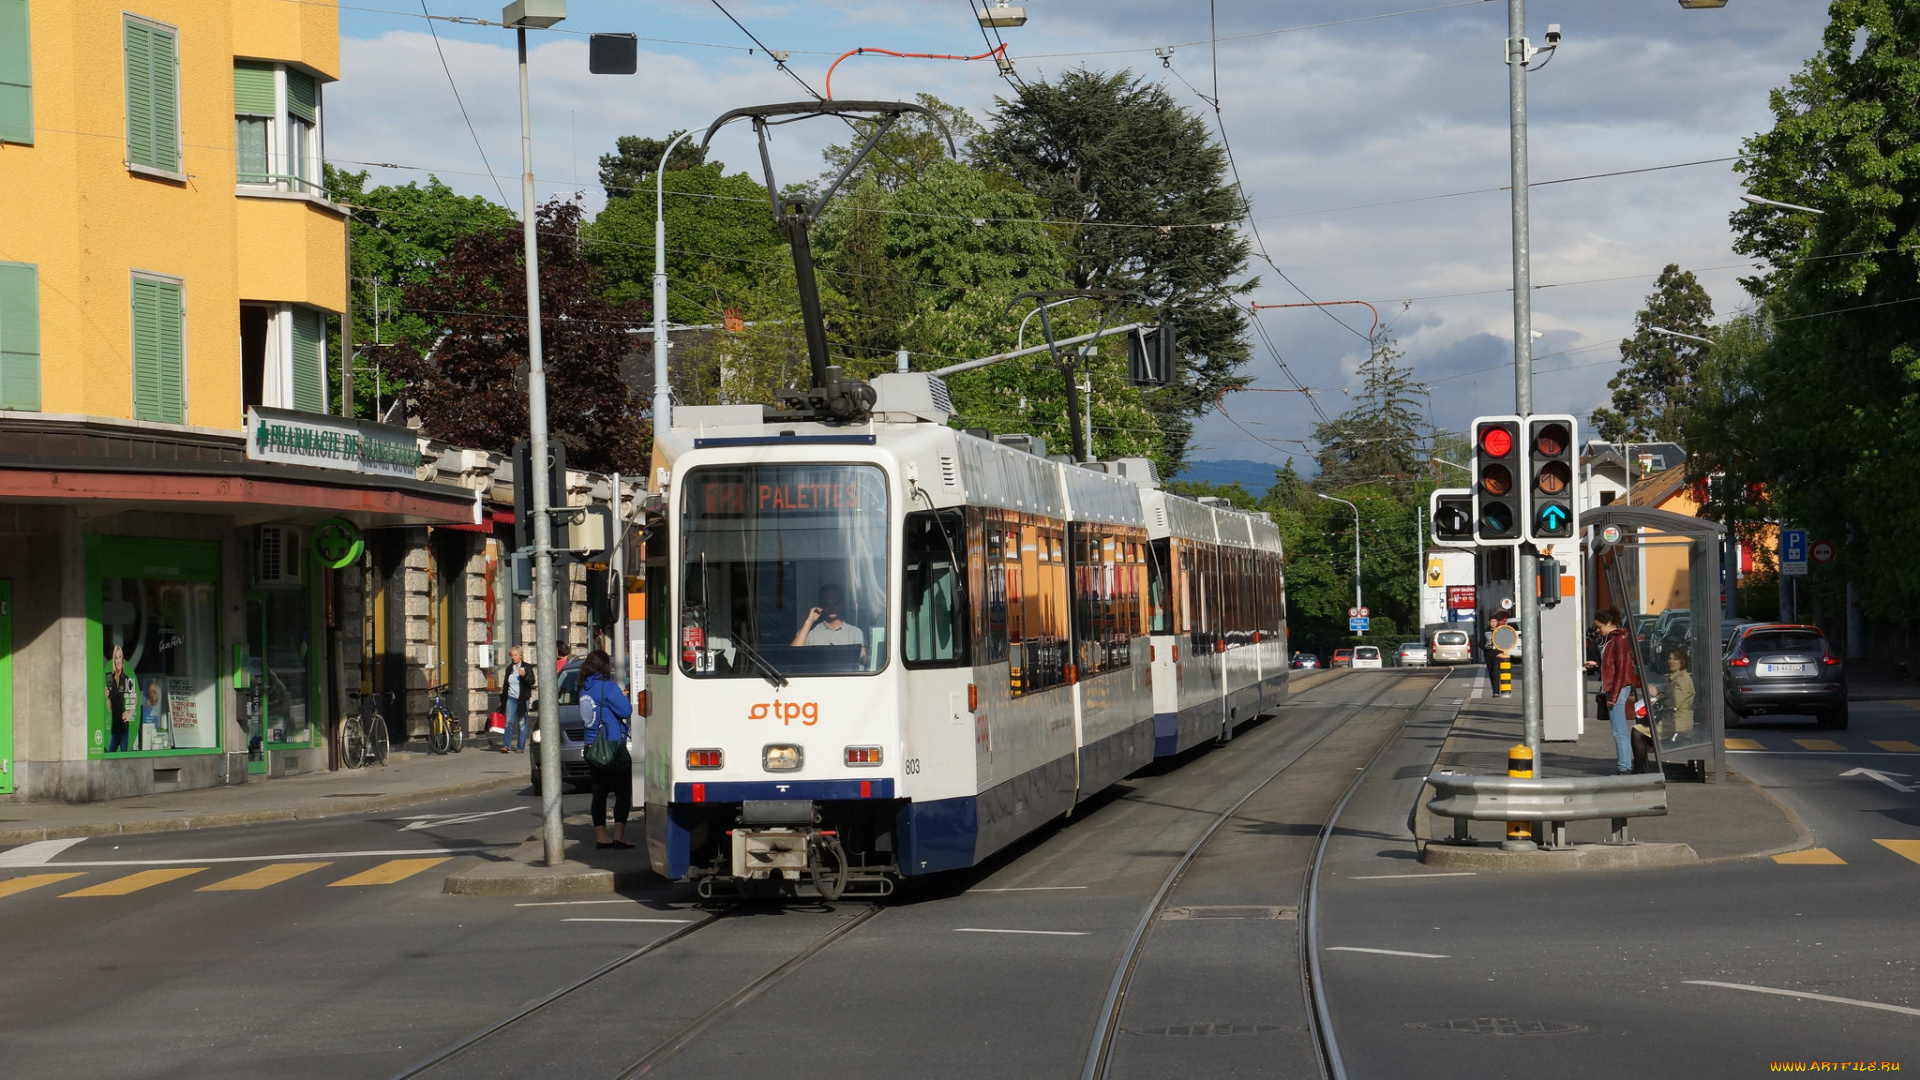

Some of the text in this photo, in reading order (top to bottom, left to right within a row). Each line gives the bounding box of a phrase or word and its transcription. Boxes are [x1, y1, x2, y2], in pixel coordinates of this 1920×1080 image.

[270, 424, 341, 453] PHARMACIE
[344, 433, 359, 456] DE
[759, 483, 858, 510] PALETTES
[1789, 533, 1800, 548] P
[124, 678, 136, 693] ICI
[773, 699, 818, 726] tpg
[905, 758, 921, 775] 803
